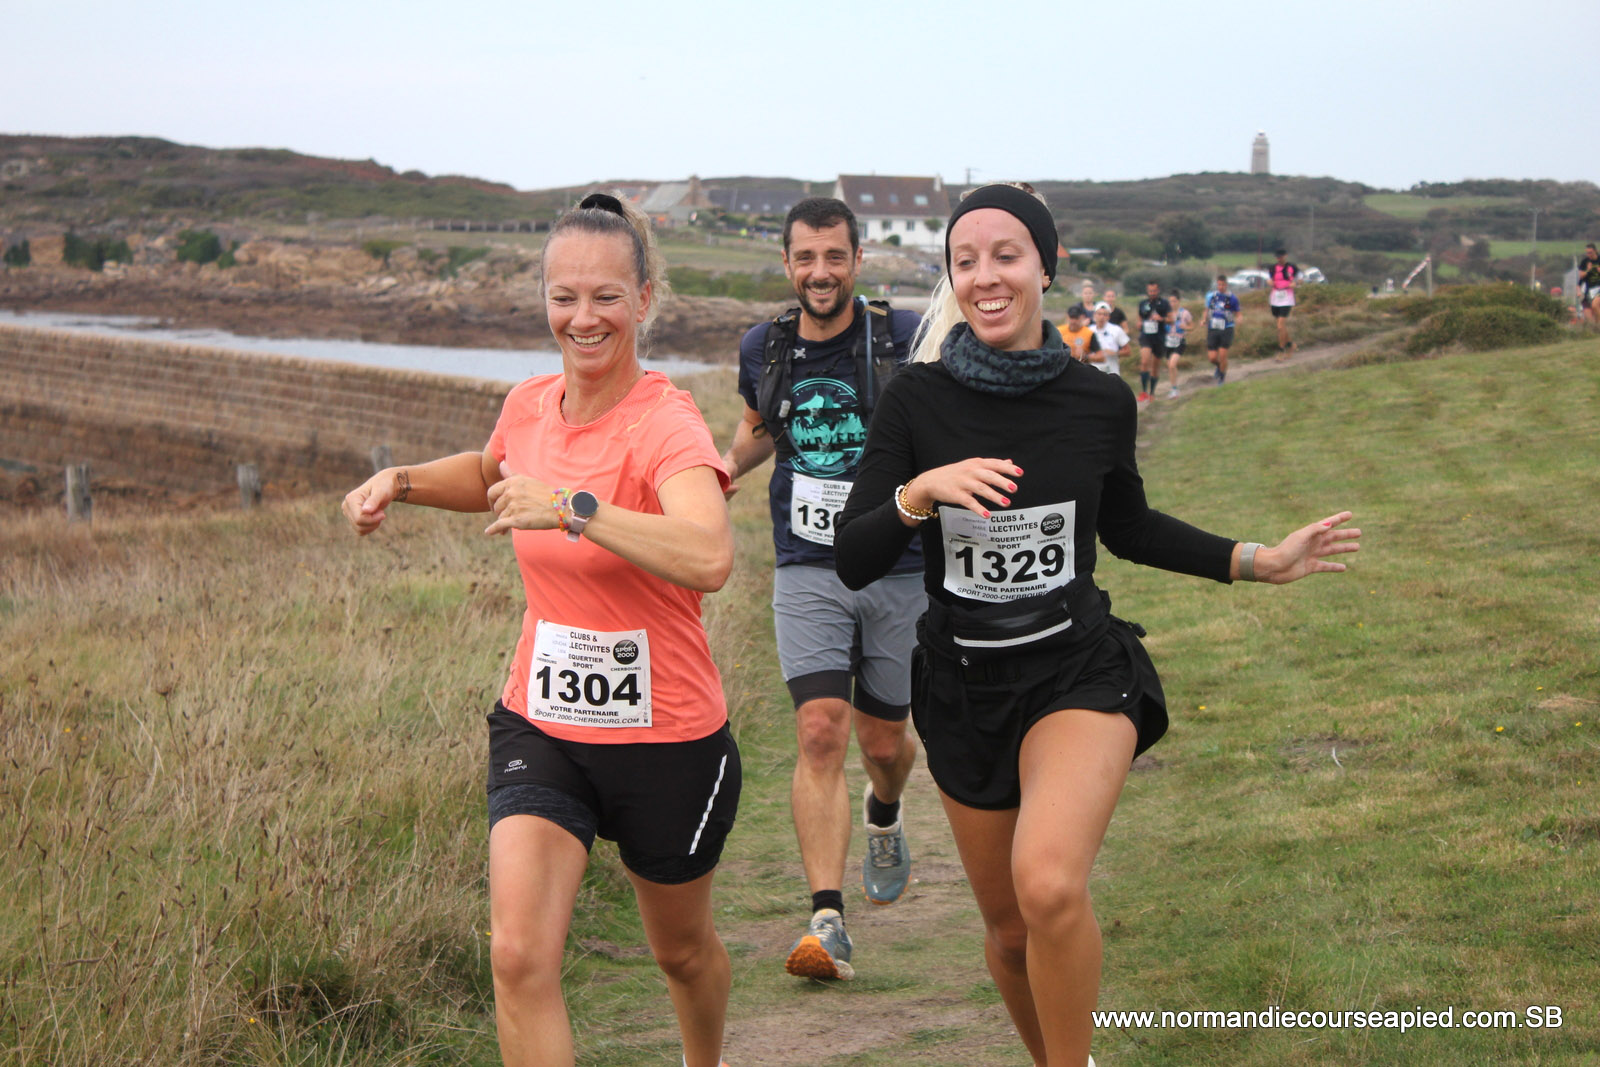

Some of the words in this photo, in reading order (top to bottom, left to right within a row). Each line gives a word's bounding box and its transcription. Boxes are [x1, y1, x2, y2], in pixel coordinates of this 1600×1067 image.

[990, 514, 1017, 523] CLUBS
[1042, 518, 1063, 526] SPORT
[988, 522, 1038, 533] LLECTIVITES
[1044, 523, 1061, 531] 2000
[988, 534, 1031, 543] EQUERTIER
[1037, 536, 1066, 545] CHERBOURG
[955, 544, 1065, 583] 1329
[974, 583, 998, 592] VOTRE
[1000, 583, 1047, 592] PARTENAIRE
[957, 588, 981, 597] SPORT
[570, 632, 591, 642] CLUBS
[569, 642, 610, 653] LECTIVITES
[568, 654, 604, 663] EQUERTIER
[536, 666, 641, 706] 1304
[550, 705, 572, 713] VOTRE
[574, 708, 619, 716] PARTENAIRE
[534, 709, 556, 719] SPORT
[557, 714, 639, 724] 2000-CHERBOURG.COM
